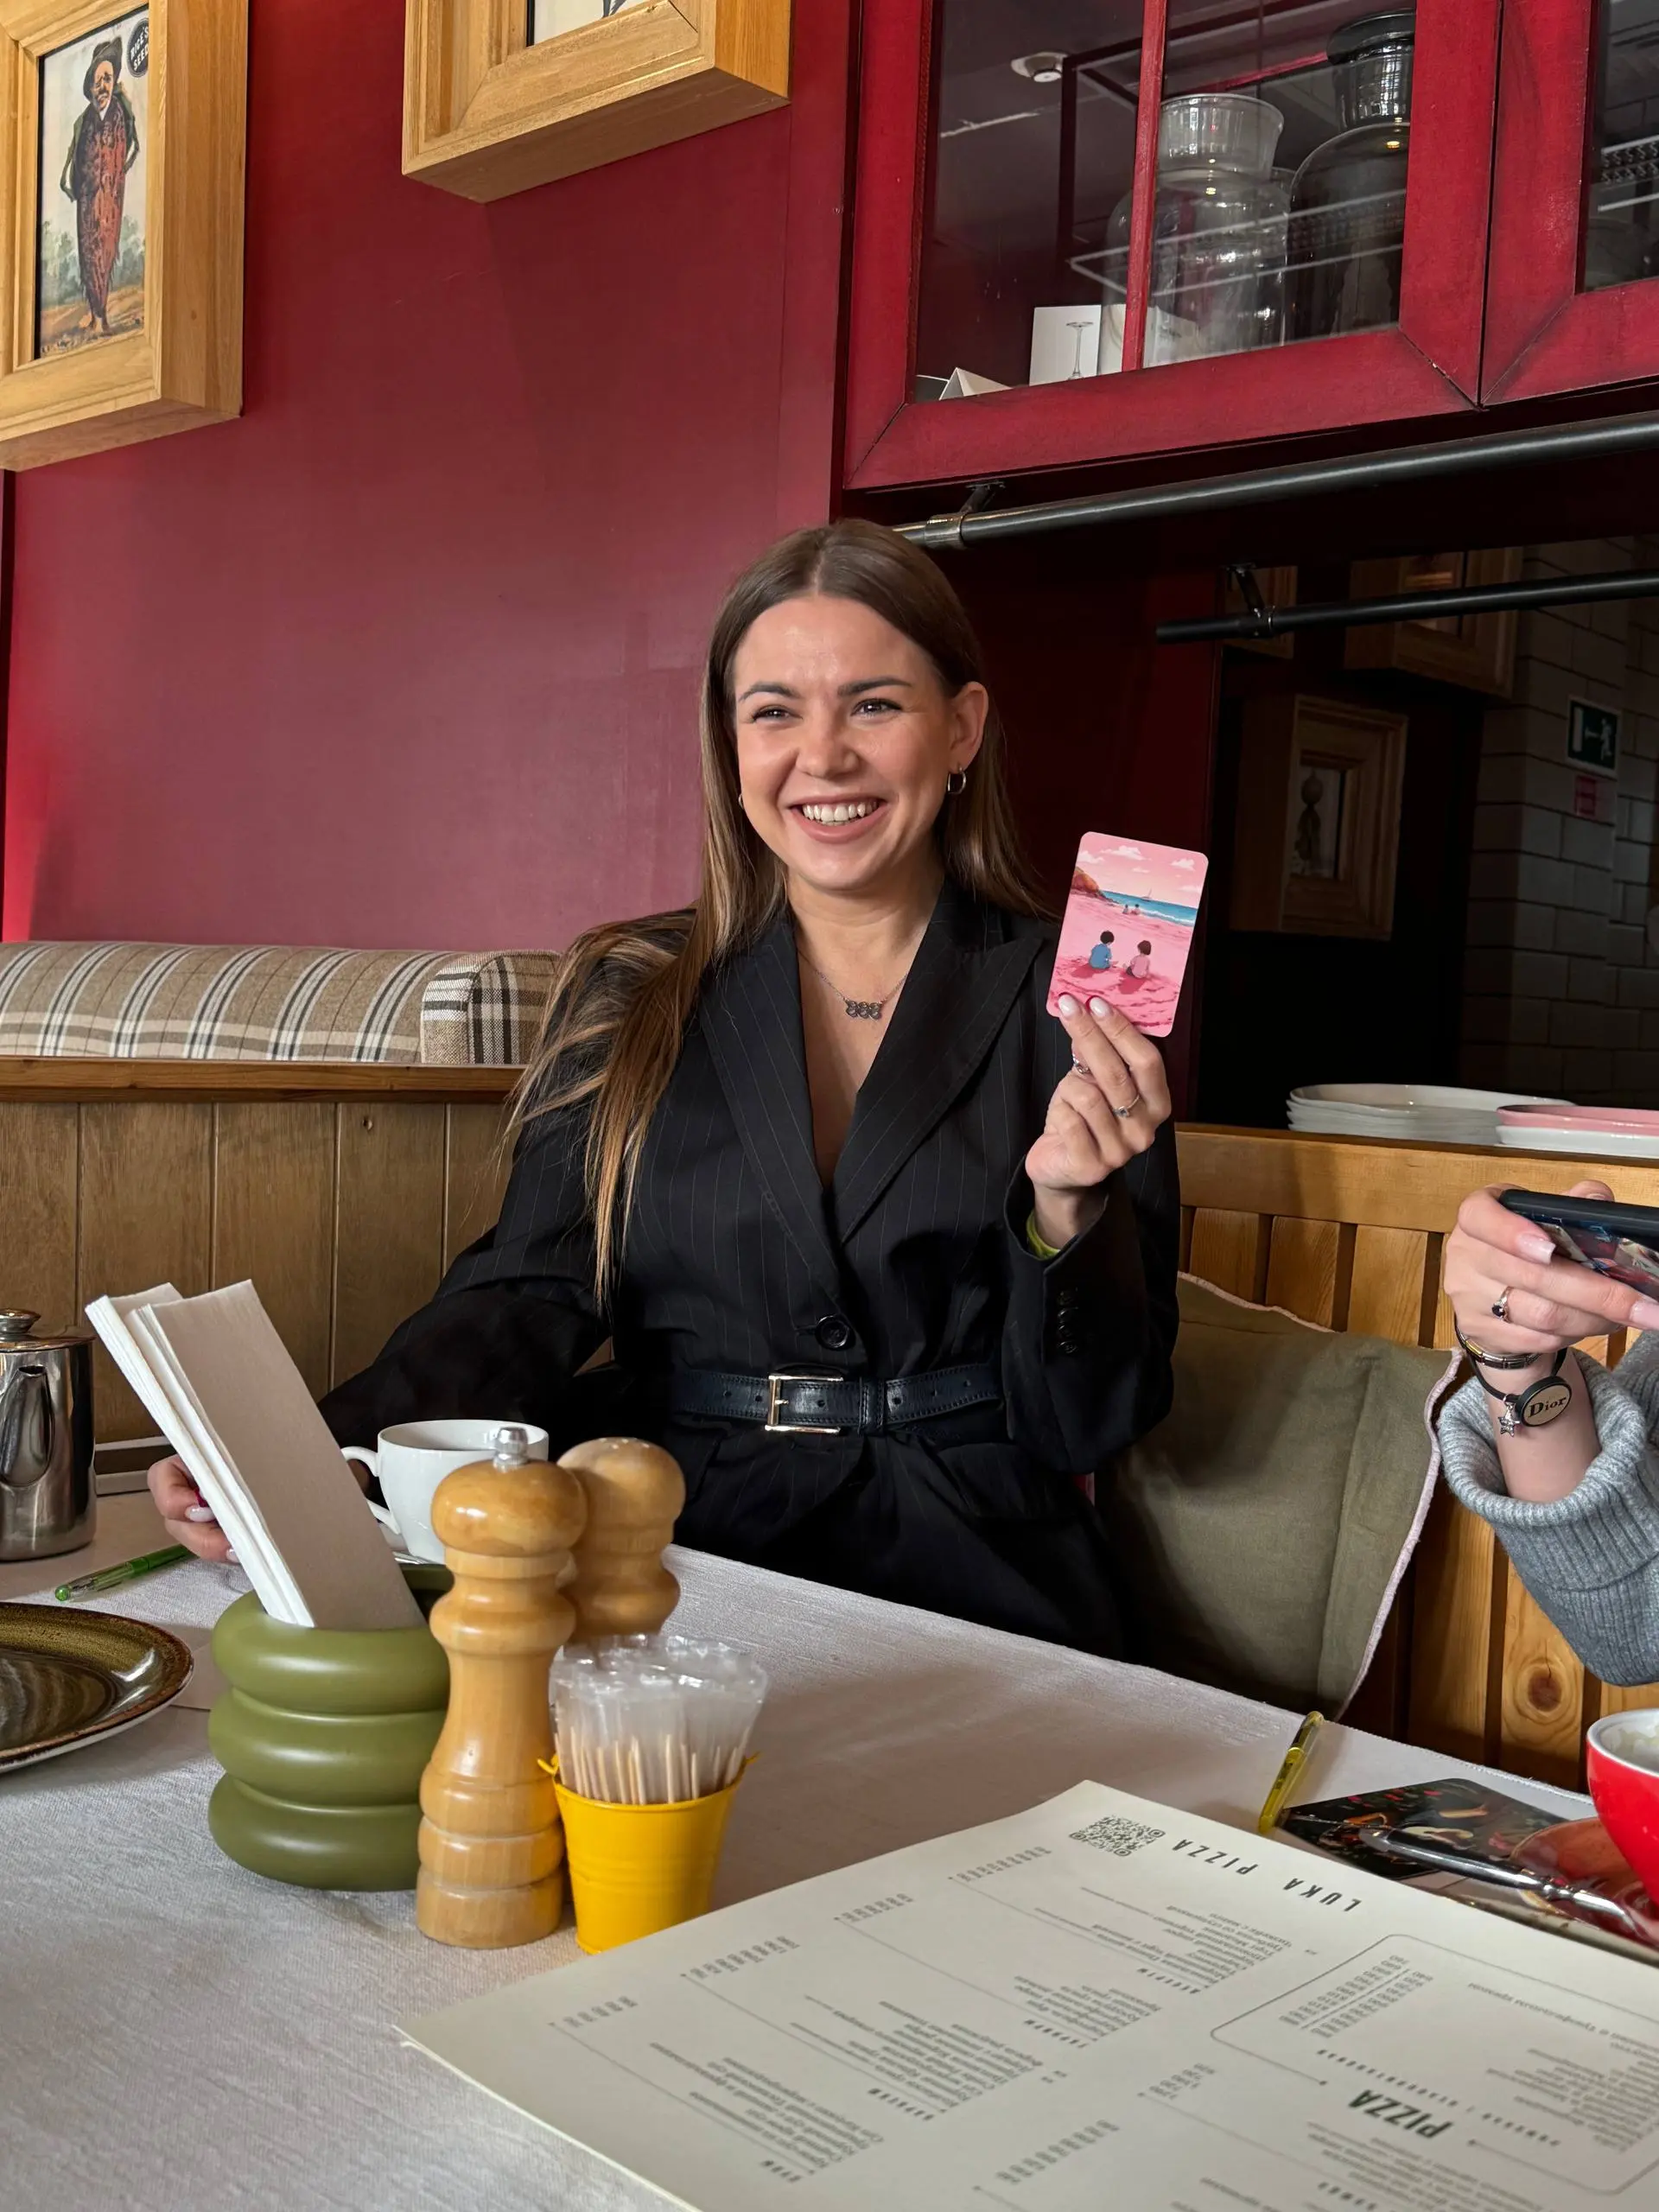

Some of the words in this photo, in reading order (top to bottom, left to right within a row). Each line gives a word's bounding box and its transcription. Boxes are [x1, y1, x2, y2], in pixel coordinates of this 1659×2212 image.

[1528, 1396, 1567, 1418] Dior
[1172, 1839, 1258, 1875] PIZZA
[1283, 1878, 1361, 1912] LUKA
[1349, 2089, 1452, 2139] PIZZA
